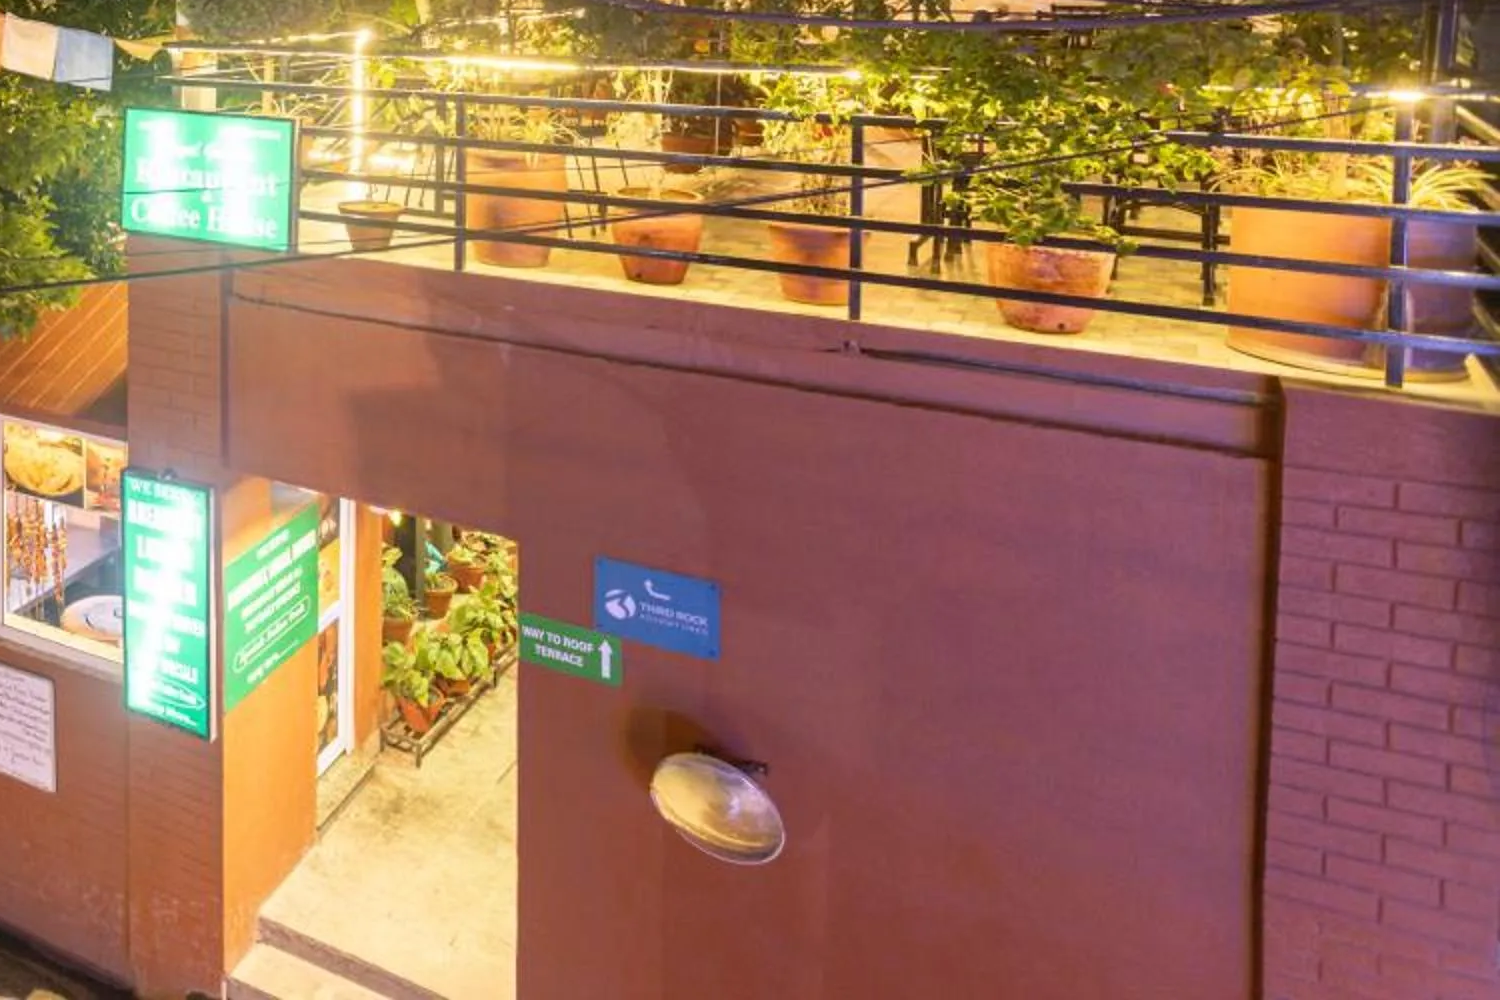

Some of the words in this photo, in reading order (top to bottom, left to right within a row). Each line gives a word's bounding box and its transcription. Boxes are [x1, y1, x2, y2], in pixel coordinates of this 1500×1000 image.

[639, 602, 675, 619] THIRD
[676, 610, 708, 627] ROCK
[521, 624, 545, 641] WAY
[546, 631, 561, 645] TO
[563, 636, 594, 653] ROOF
[534, 642, 584, 668] TERRACE
